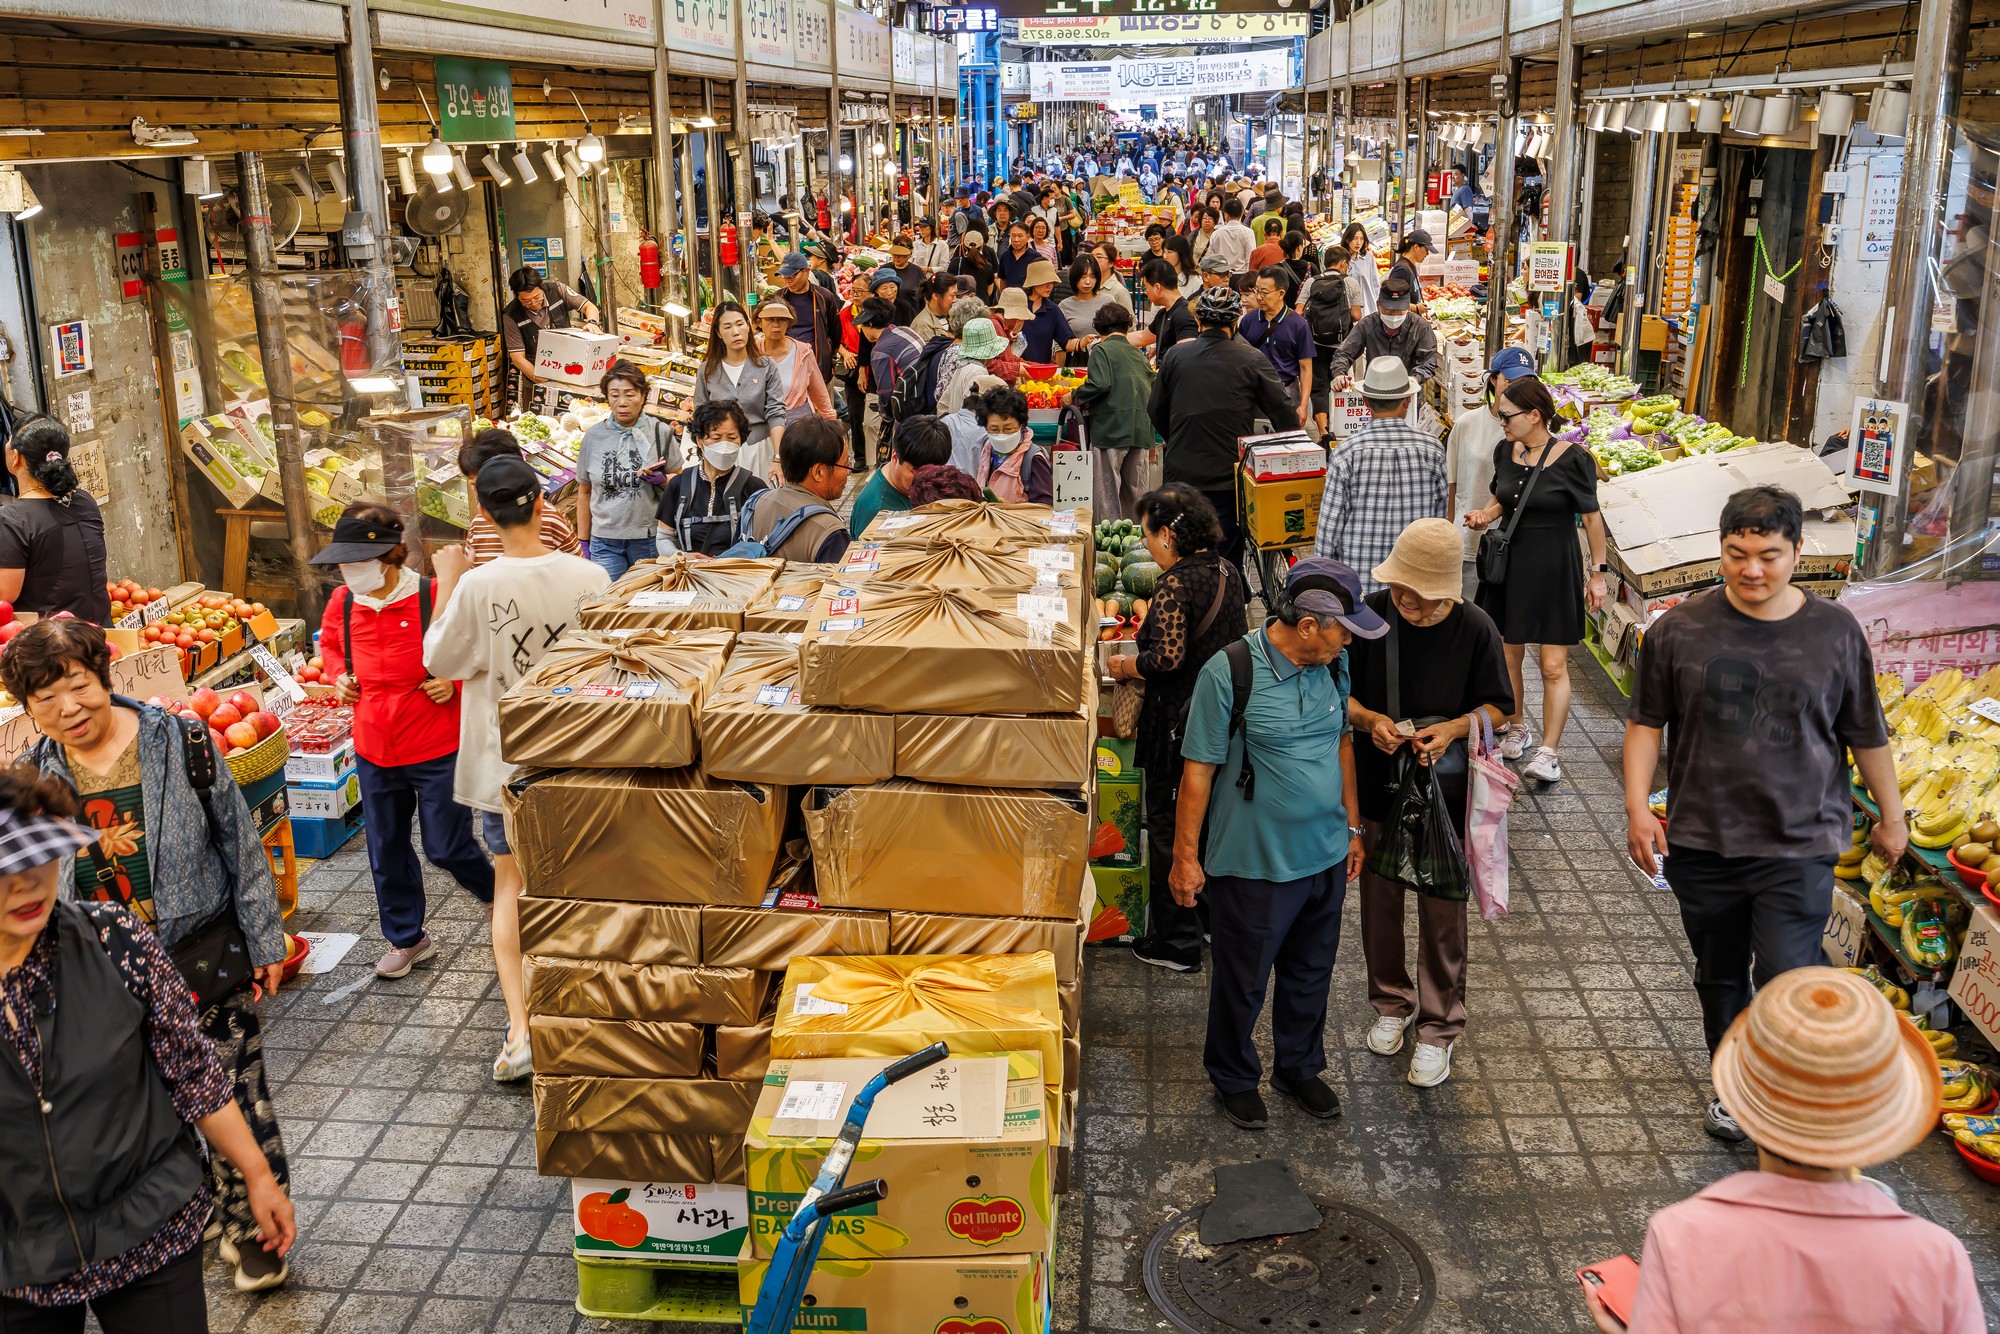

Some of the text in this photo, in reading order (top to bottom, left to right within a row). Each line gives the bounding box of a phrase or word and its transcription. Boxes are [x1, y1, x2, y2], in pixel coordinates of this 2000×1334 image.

[444, 84, 510, 118] 강오 상회
[121, 252, 143, 276] CCT
[1535, 258, 1560, 268] 환급행사
[1534, 269, 1559, 279] 참여점포
[540, 359, 563, 370] 사과
[1519, 353, 1528, 365] LA
[592, 359, 605, 371] 사과
[1347, 409, 1363, 417] 한장
[1115, 853, 1130, 861] 20kg
[677, 1207, 734, 1230] 사과
[952, 1211, 1019, 1225] Del Monte
[971, 1225, 1000, 1235] Quality
